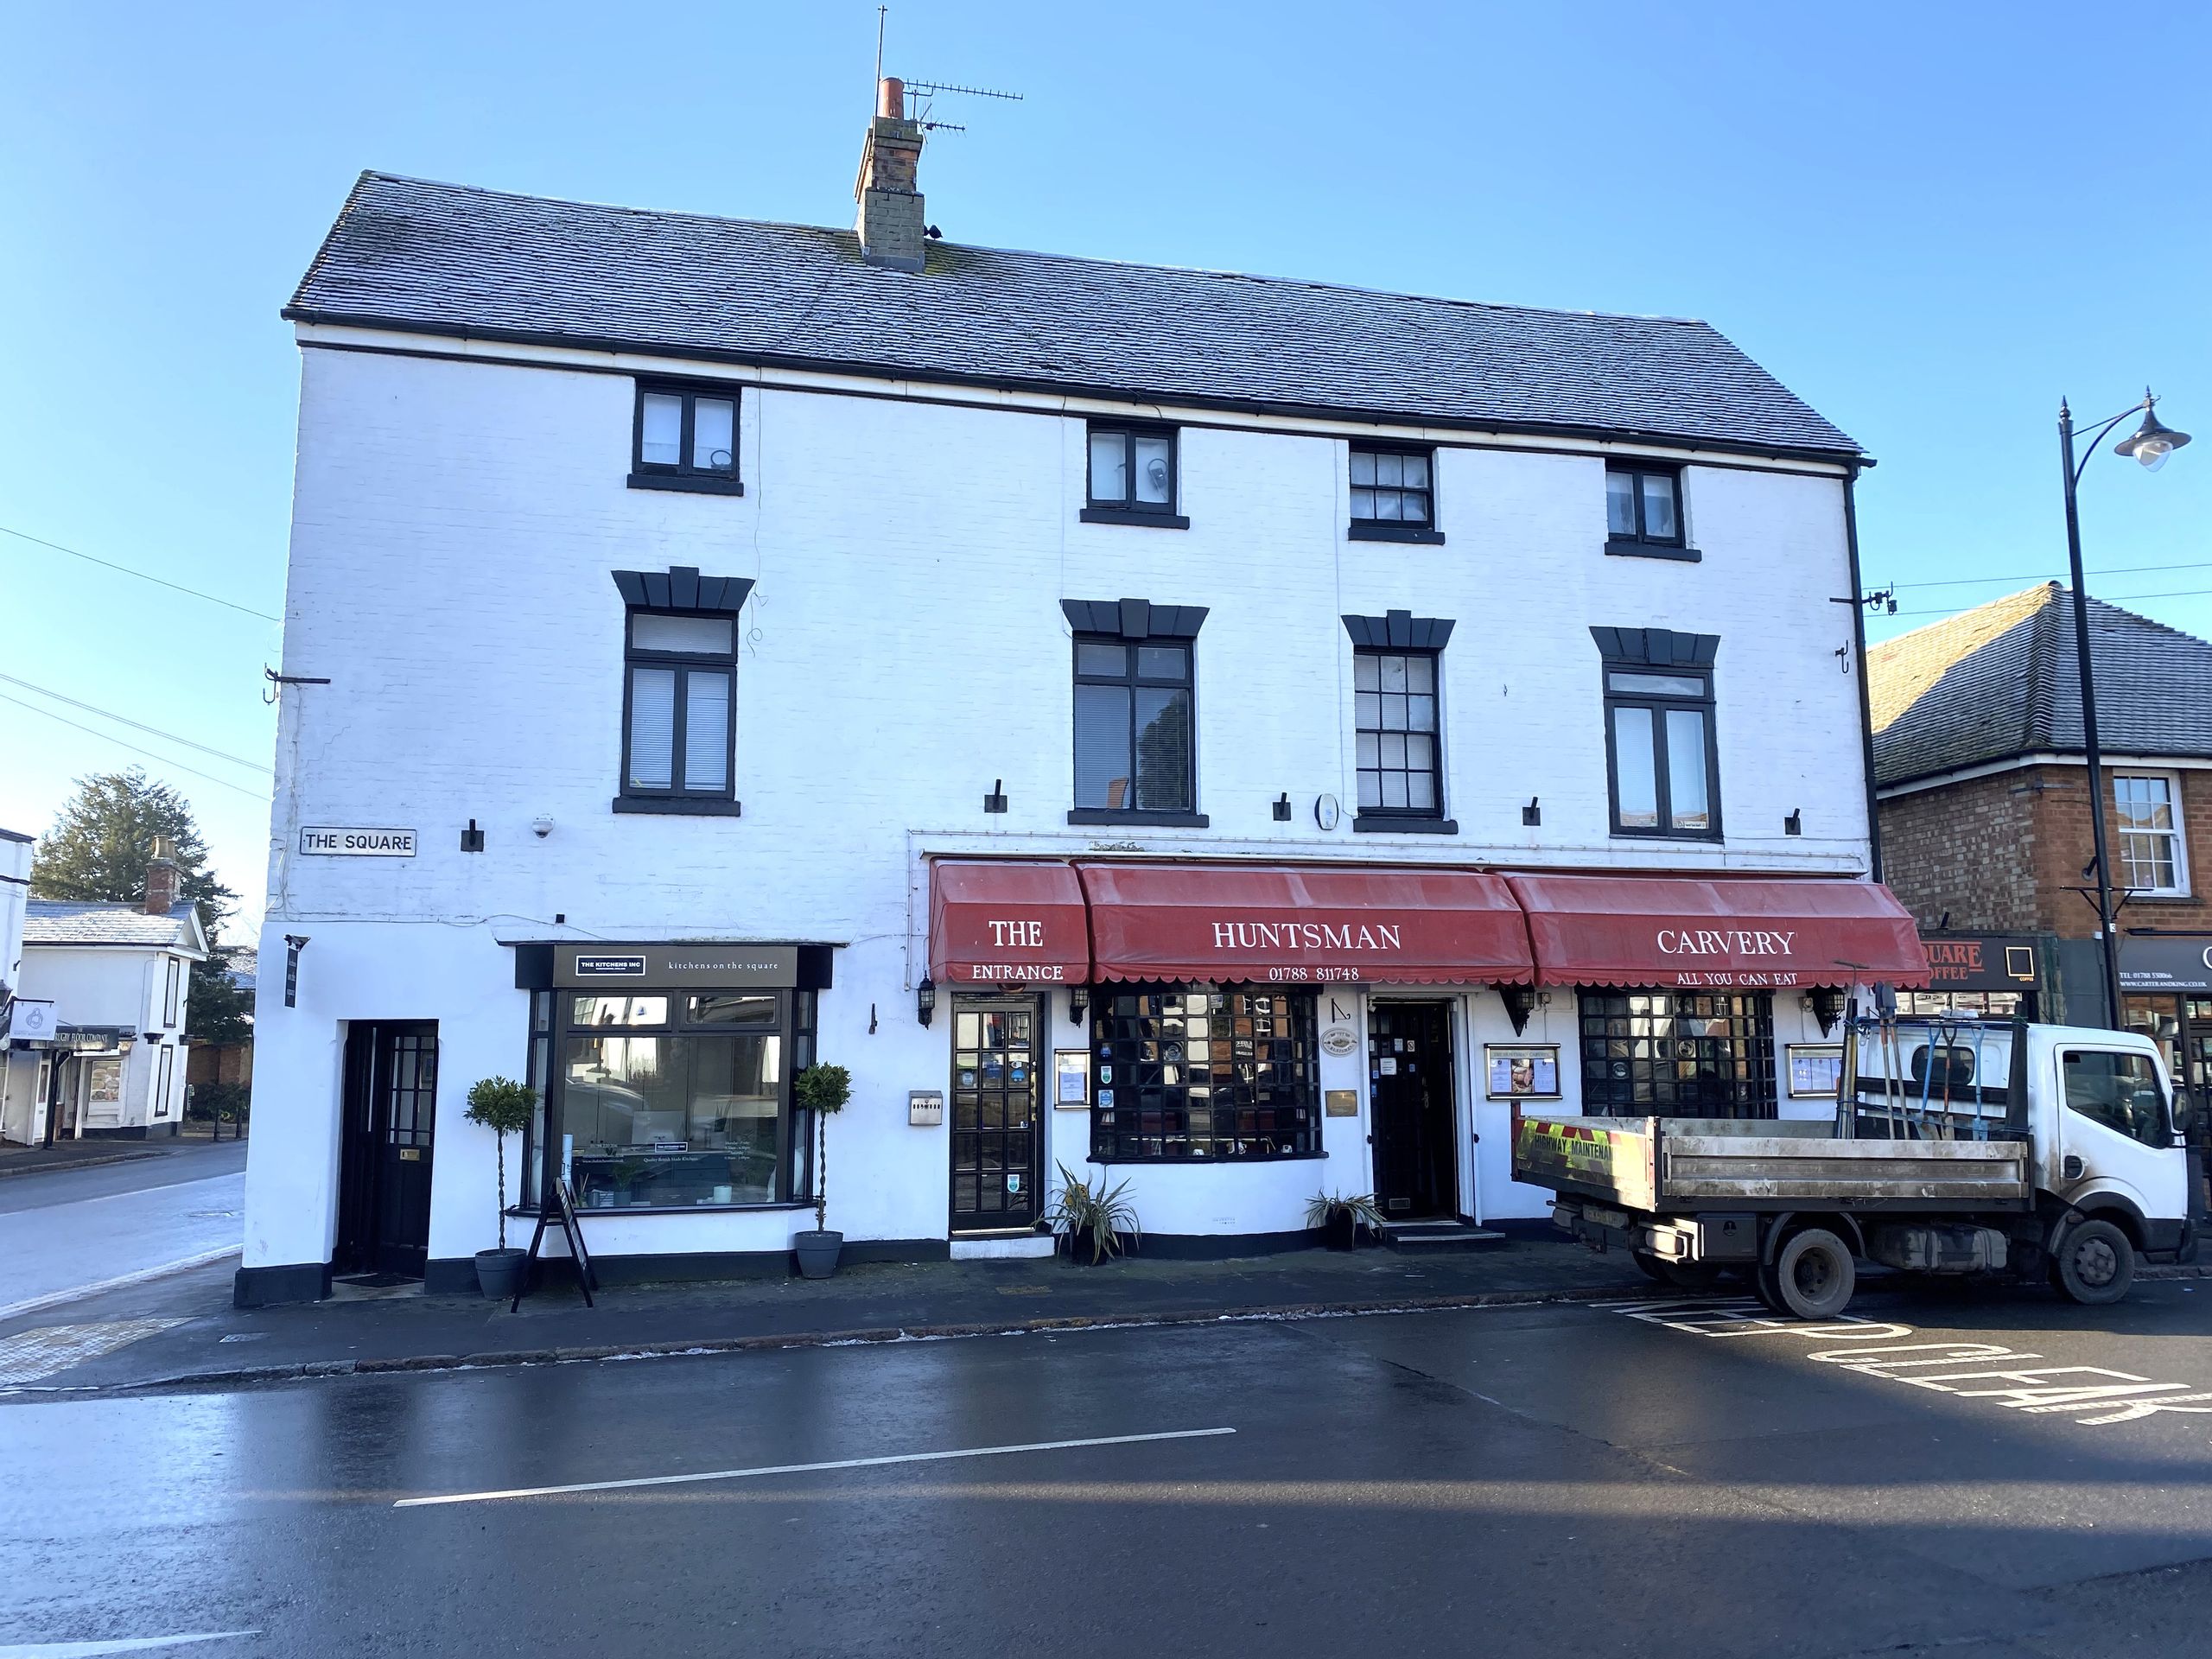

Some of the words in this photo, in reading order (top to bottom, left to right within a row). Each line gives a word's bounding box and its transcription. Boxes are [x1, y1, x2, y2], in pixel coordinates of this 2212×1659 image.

[305, 834, 338, 849] THE
[345, 835, 412, 850] SQUARE
[988, 920, 1044, 947] THE
[1211, 922, 1402, 950] HUNTSMAN
[1656, 930, 1796, 955] CARVERY
[1922, 944, 1983, 968] UARE
[668, 961, 710, 969] kitchens
[747, 963, 779, 971] square
[972, 964, 1064, 980] ENTRANCE
[1268, 967, 1308, 981] 01788
[1316, 967, 1360, 981] 811748
[1677, 972, 1702, 985] ALL
[1704, 973, 1732, 985] YOU
[1738, 973, 1768, 986] CAN
[1772, 973, 1798, 986] EAT
[71, 1033, 86, 1043] FLOOR
[86, 1033, 108, 1042] COMPANY
[1535, 1134, 1567, 1154] HIGHWAY
